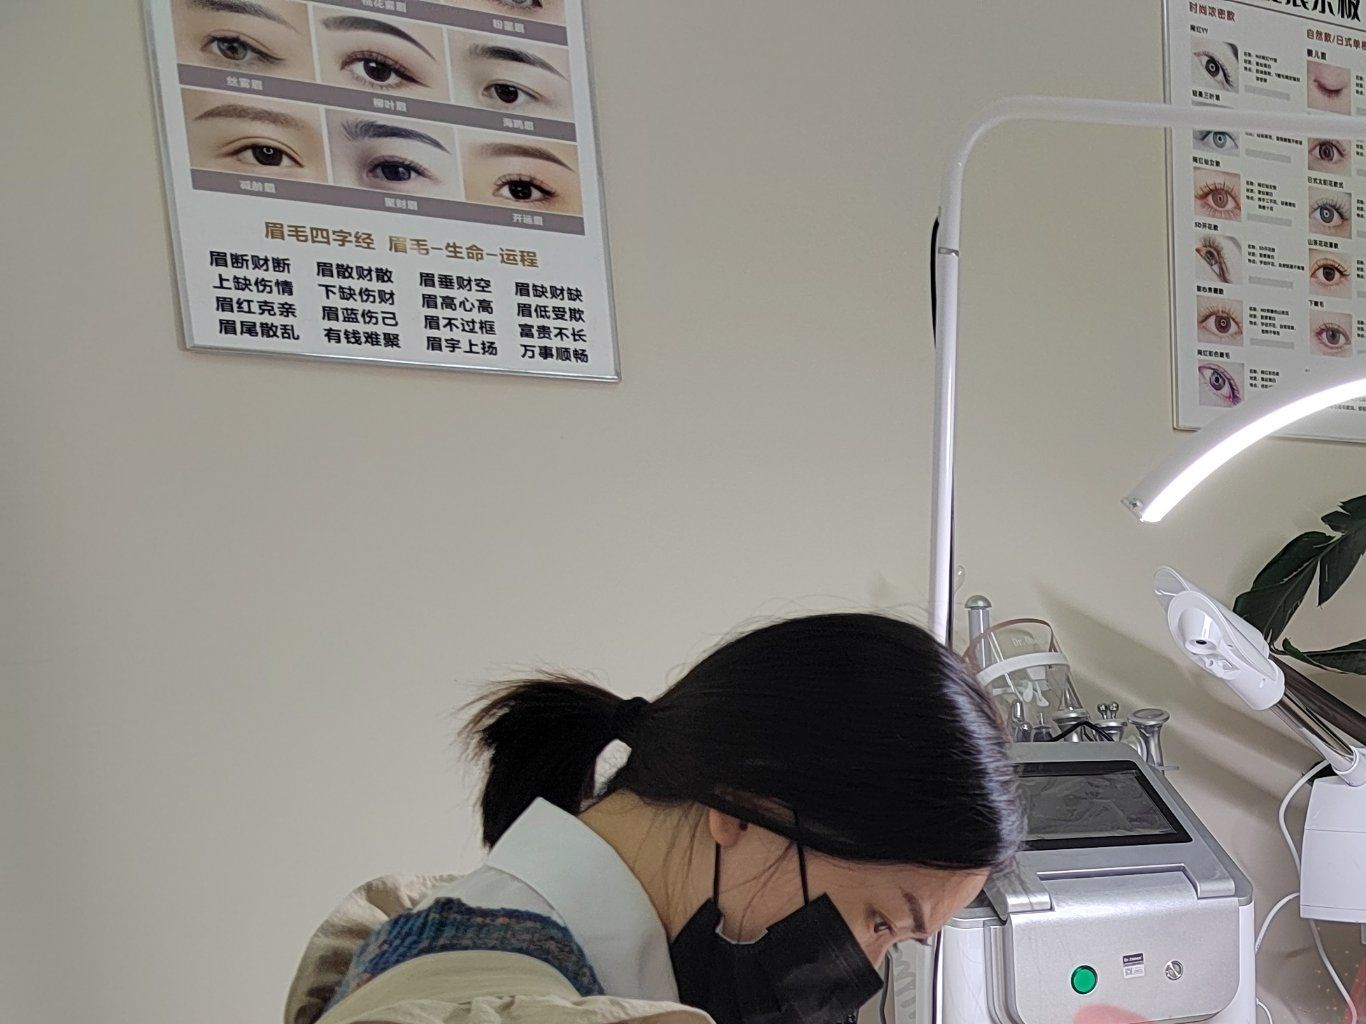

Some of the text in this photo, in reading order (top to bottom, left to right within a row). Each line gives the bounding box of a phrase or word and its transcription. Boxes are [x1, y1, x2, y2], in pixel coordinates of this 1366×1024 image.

[264, 221, 376, 250] 眉毛四字经
[209, 250, 584, 303] 眉断财断 眉散财散 眉垂财空 眉缺财缺
[212, 273, 585, 323] 上缺伤情 下缺伤财 眉高心高 眉低受欺
[216, 296, 587, 343] 眉红克亲 眉蓝伤己 眉不过框 富贵不长
[219, 319, 589, 364] 眉尾散乱 有钱难聚 眉宇上扬 万事顺畅
